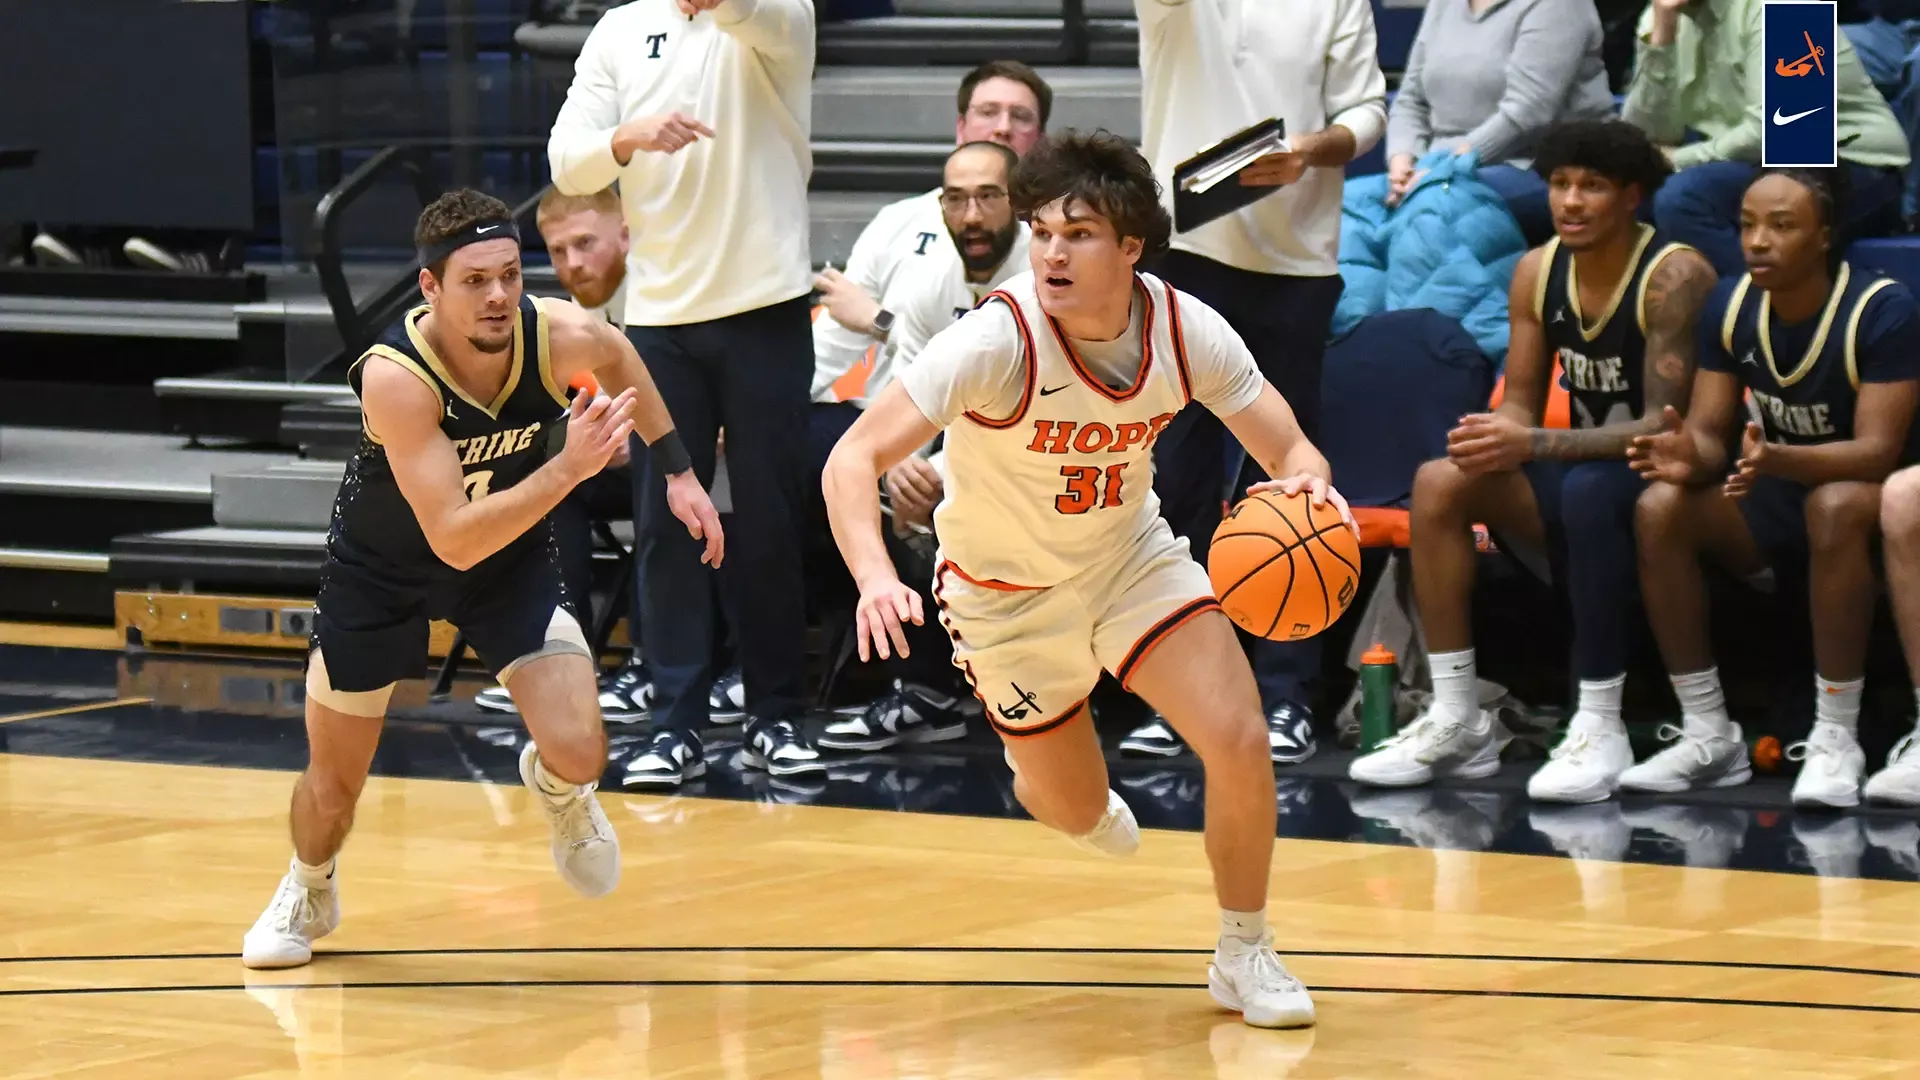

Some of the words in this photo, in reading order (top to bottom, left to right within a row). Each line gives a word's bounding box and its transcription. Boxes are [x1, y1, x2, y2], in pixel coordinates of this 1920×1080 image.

[646, 32, 667, 59] T
[914, 232, 938, 256] T
[1055, 461, 1130, 514] 31
